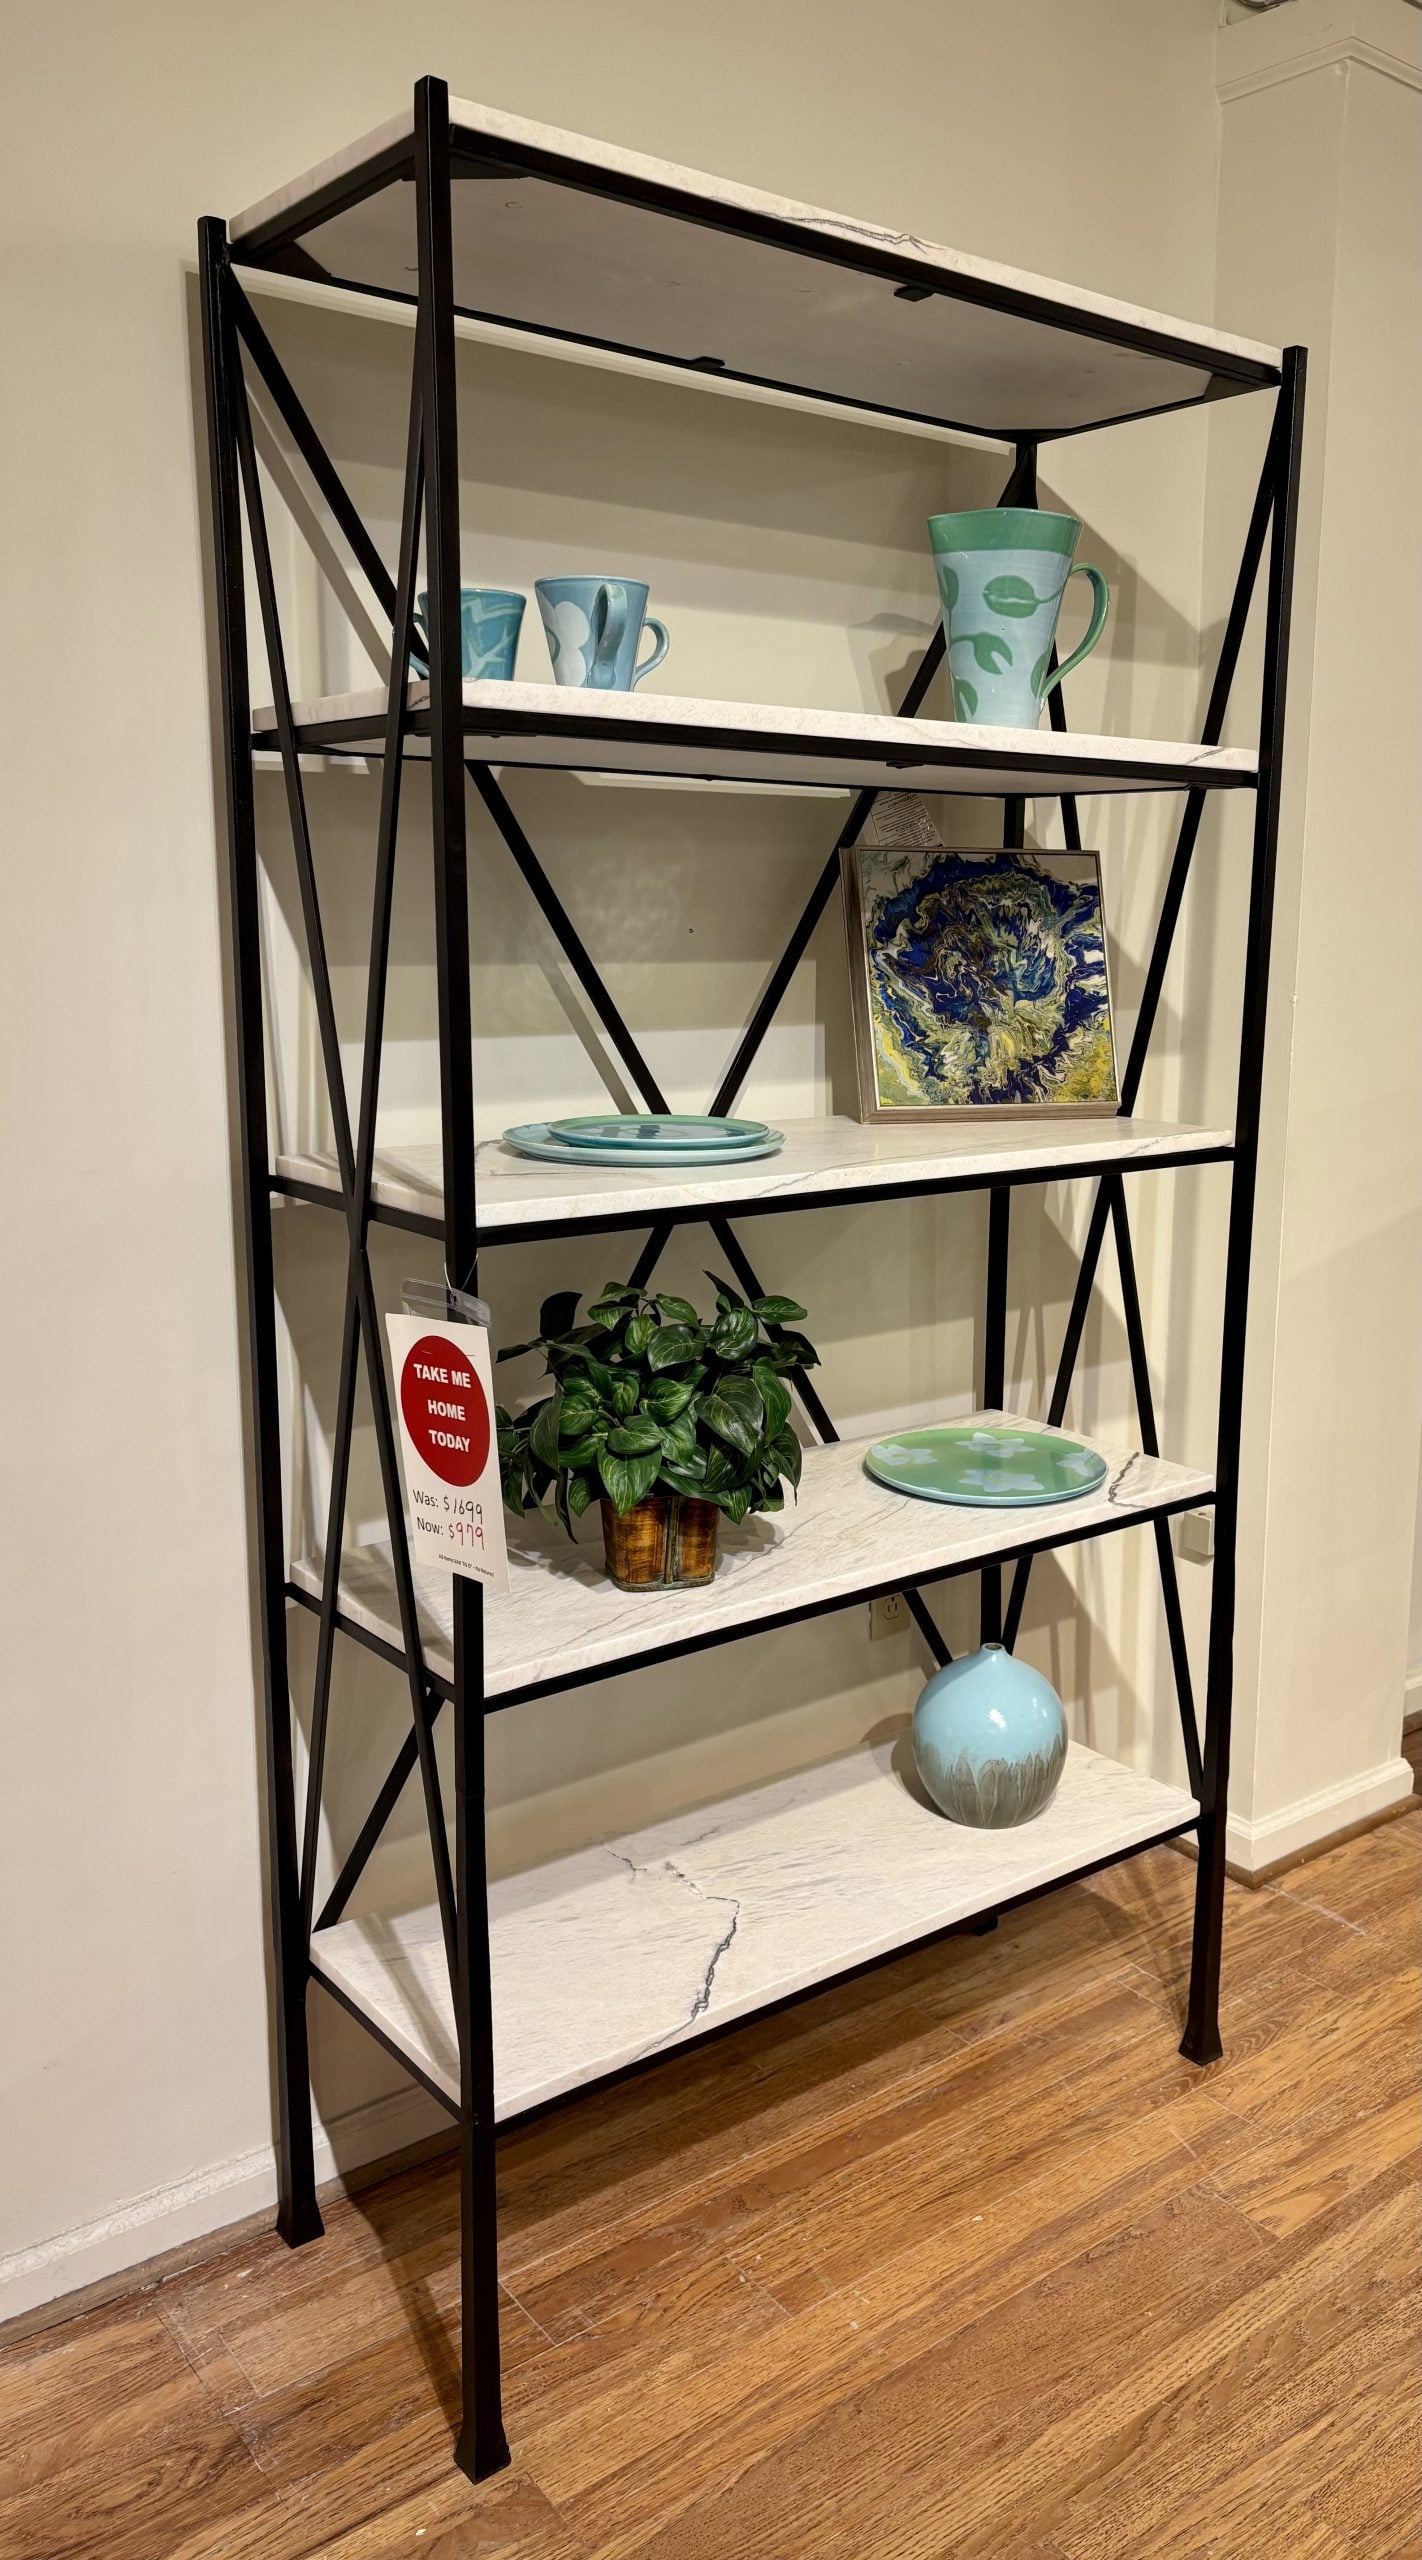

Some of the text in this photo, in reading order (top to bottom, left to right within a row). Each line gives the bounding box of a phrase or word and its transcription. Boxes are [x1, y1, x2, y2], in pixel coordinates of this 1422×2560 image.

[413, 1363, 472, 1389] TAKE ME
[427, 1399, 466, 1421] HOME
[428, 1429, 470, 1453] TODAY
[412, 1489, 439, 1508] Was:
[416, 1516, 485, 1551] Now: $979
